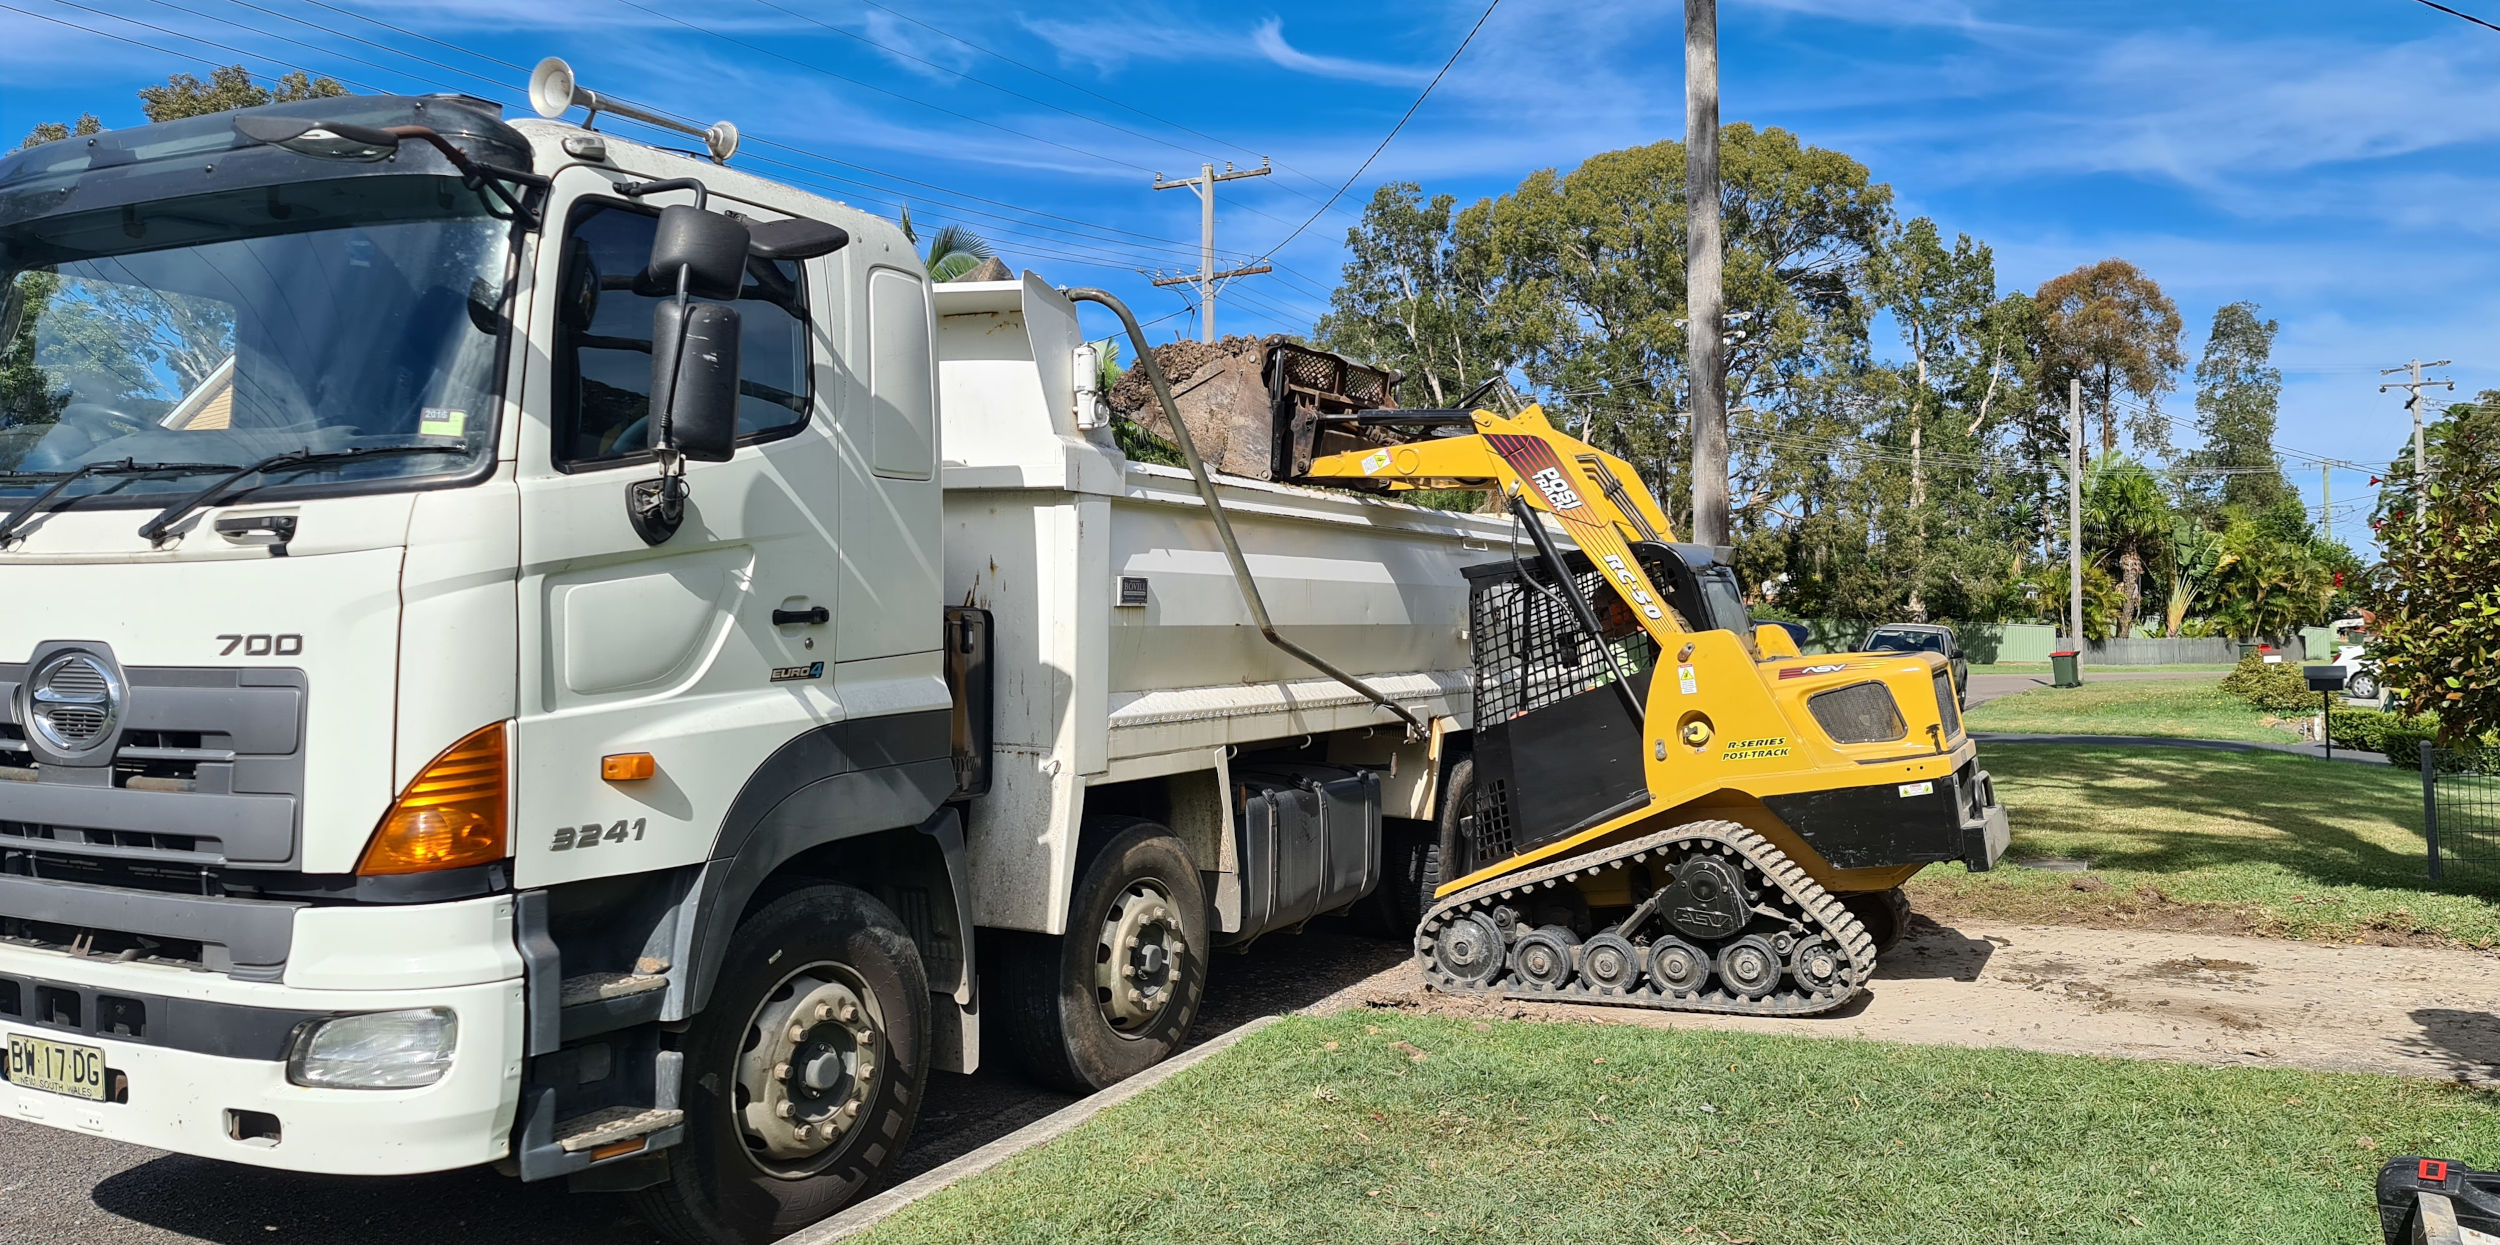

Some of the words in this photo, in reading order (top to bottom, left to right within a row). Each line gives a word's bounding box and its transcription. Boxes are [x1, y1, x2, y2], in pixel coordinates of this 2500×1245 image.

[1532, 471, 1563, 512] TRACK
[1536, 467, 1583, 510] POSI
[216, 634, 303, 656] 700
[1801, 663, 1847, 674] ASV
[1723, 748, 1789, 760] POSI-TRACK
[1727, 738, 1785, 749] R-SERIES
[550, 817, 646, 851] 3241
[20, 1077, 36, 1086] NEW
[39, 1080, 64, 1092] SOUTH
[67, 1085, 92, 1097] WALES
